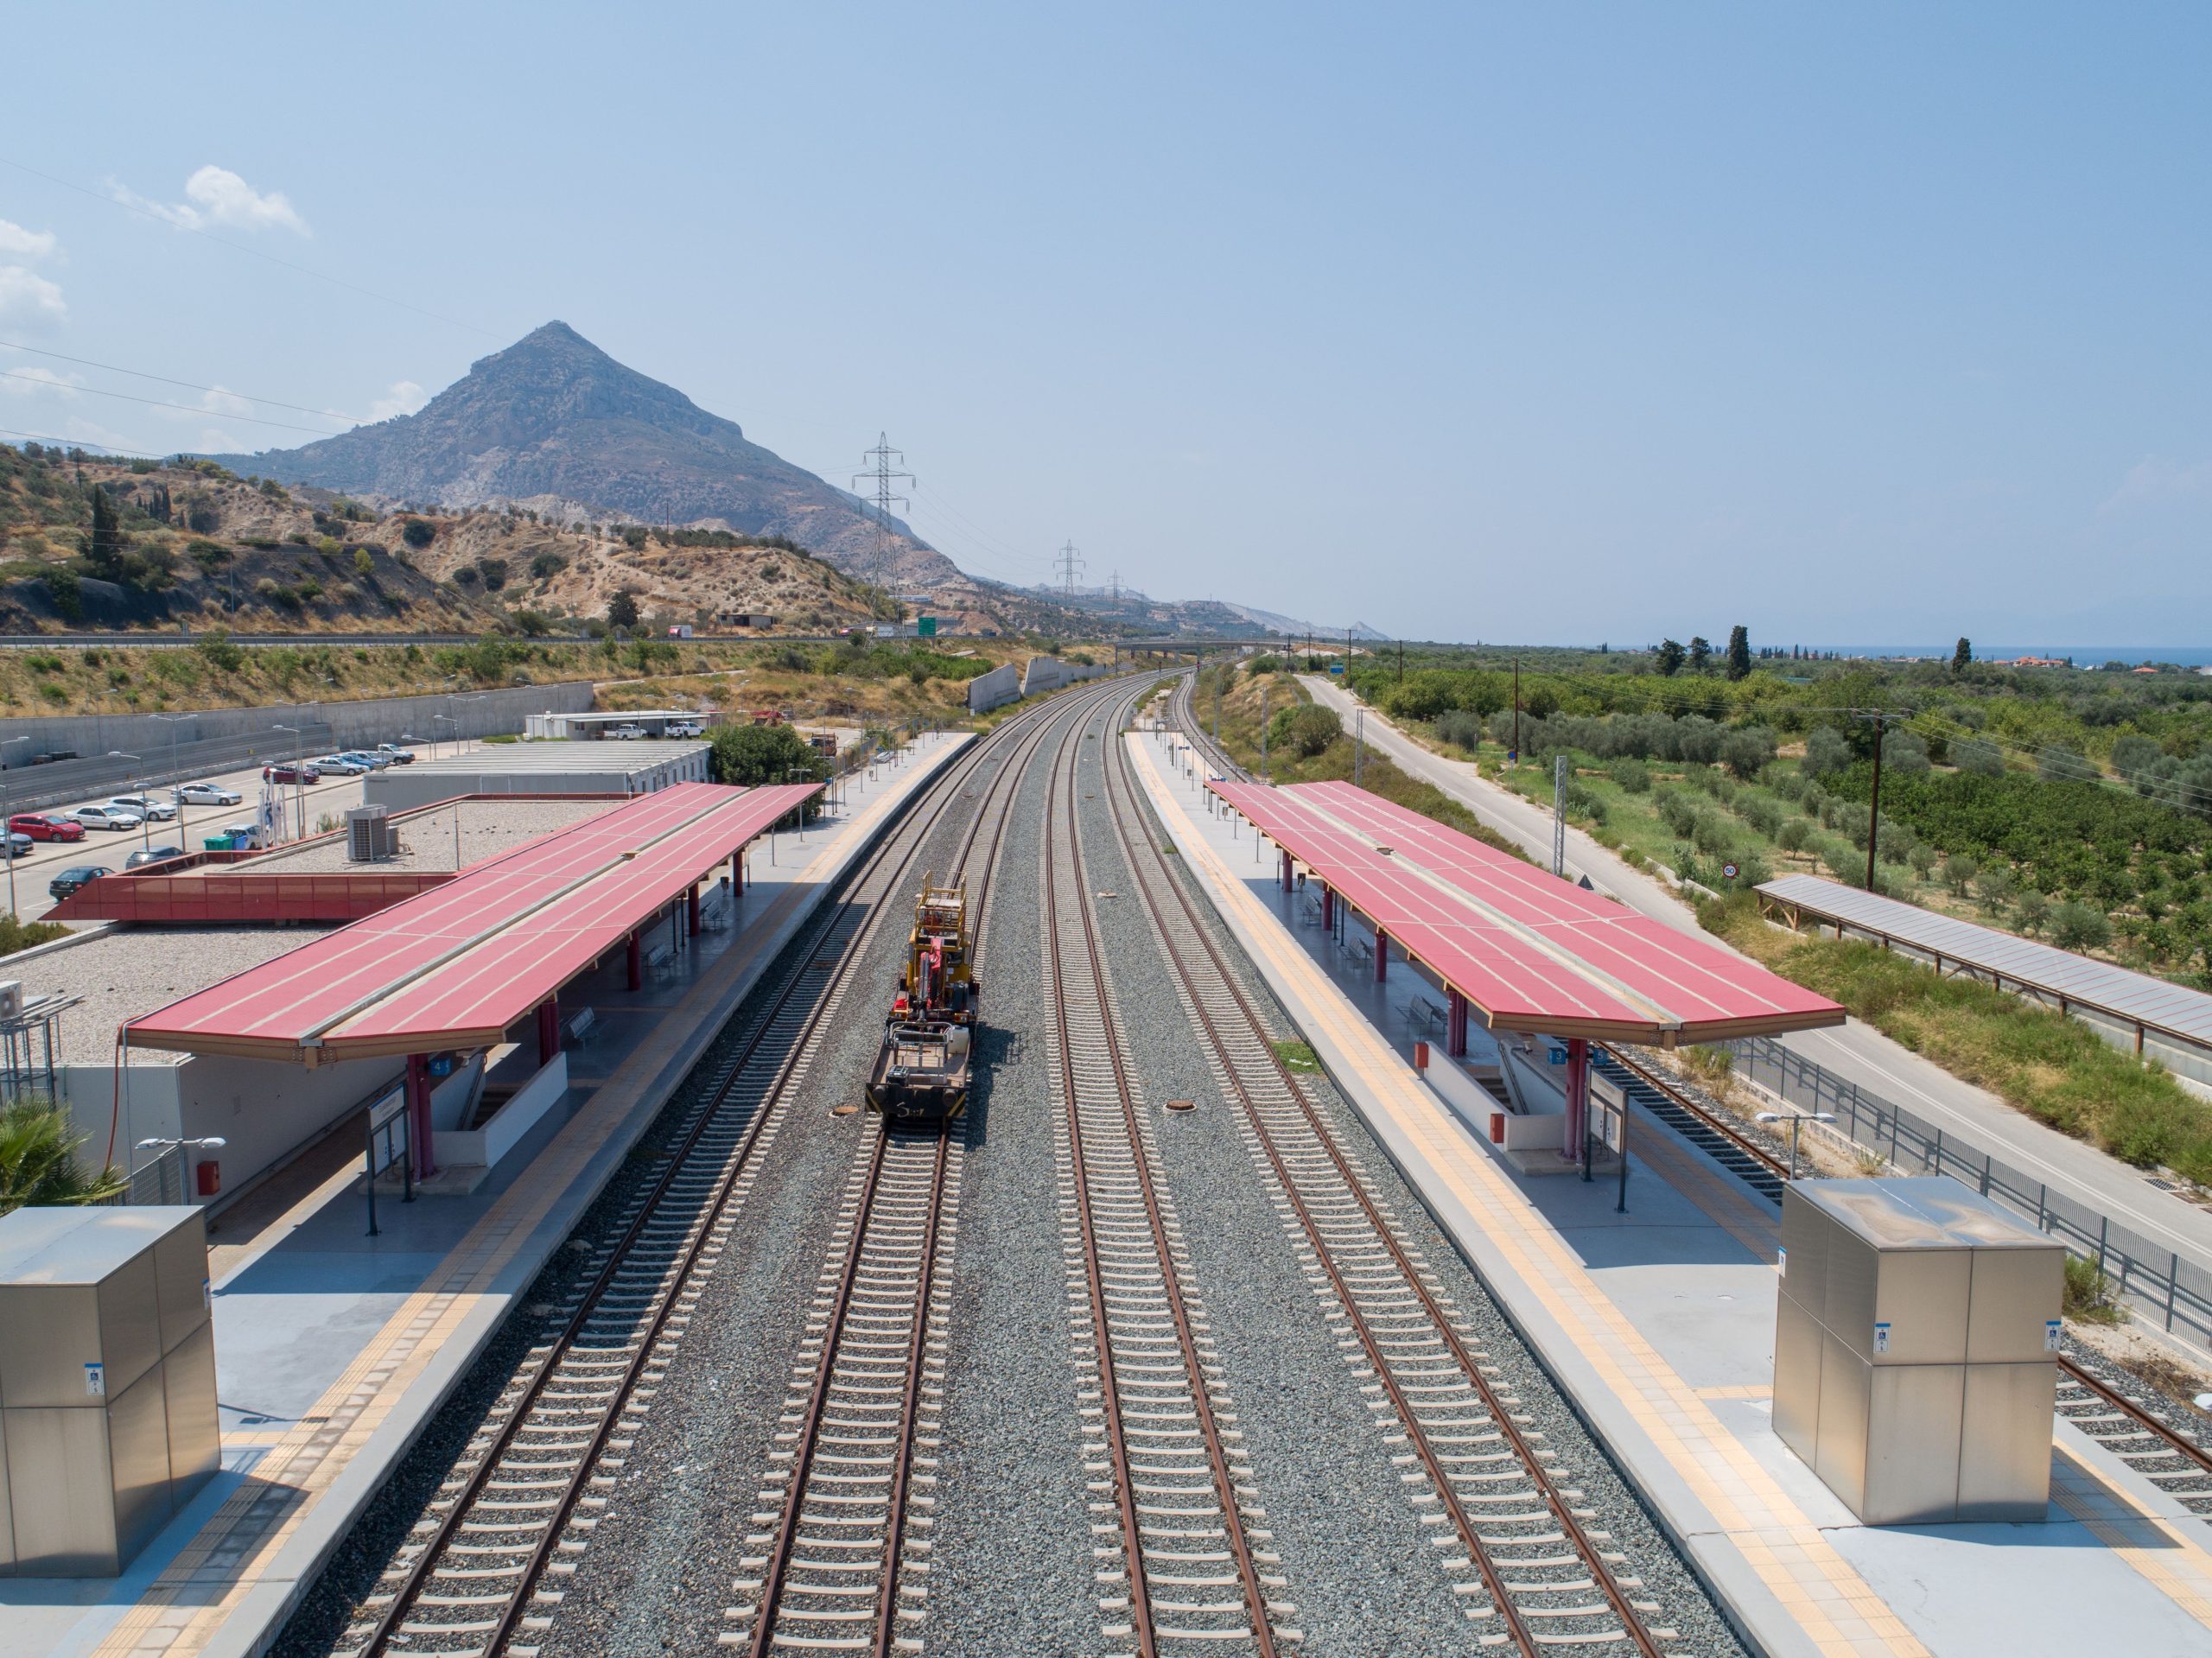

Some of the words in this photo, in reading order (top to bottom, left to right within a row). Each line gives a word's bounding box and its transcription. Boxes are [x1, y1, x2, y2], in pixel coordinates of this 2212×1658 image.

[1556, 1051, 1562, 1060] 3
[1598, 1051, 1604, 1060] 5
[434, 1062, 442, 1070] 4
